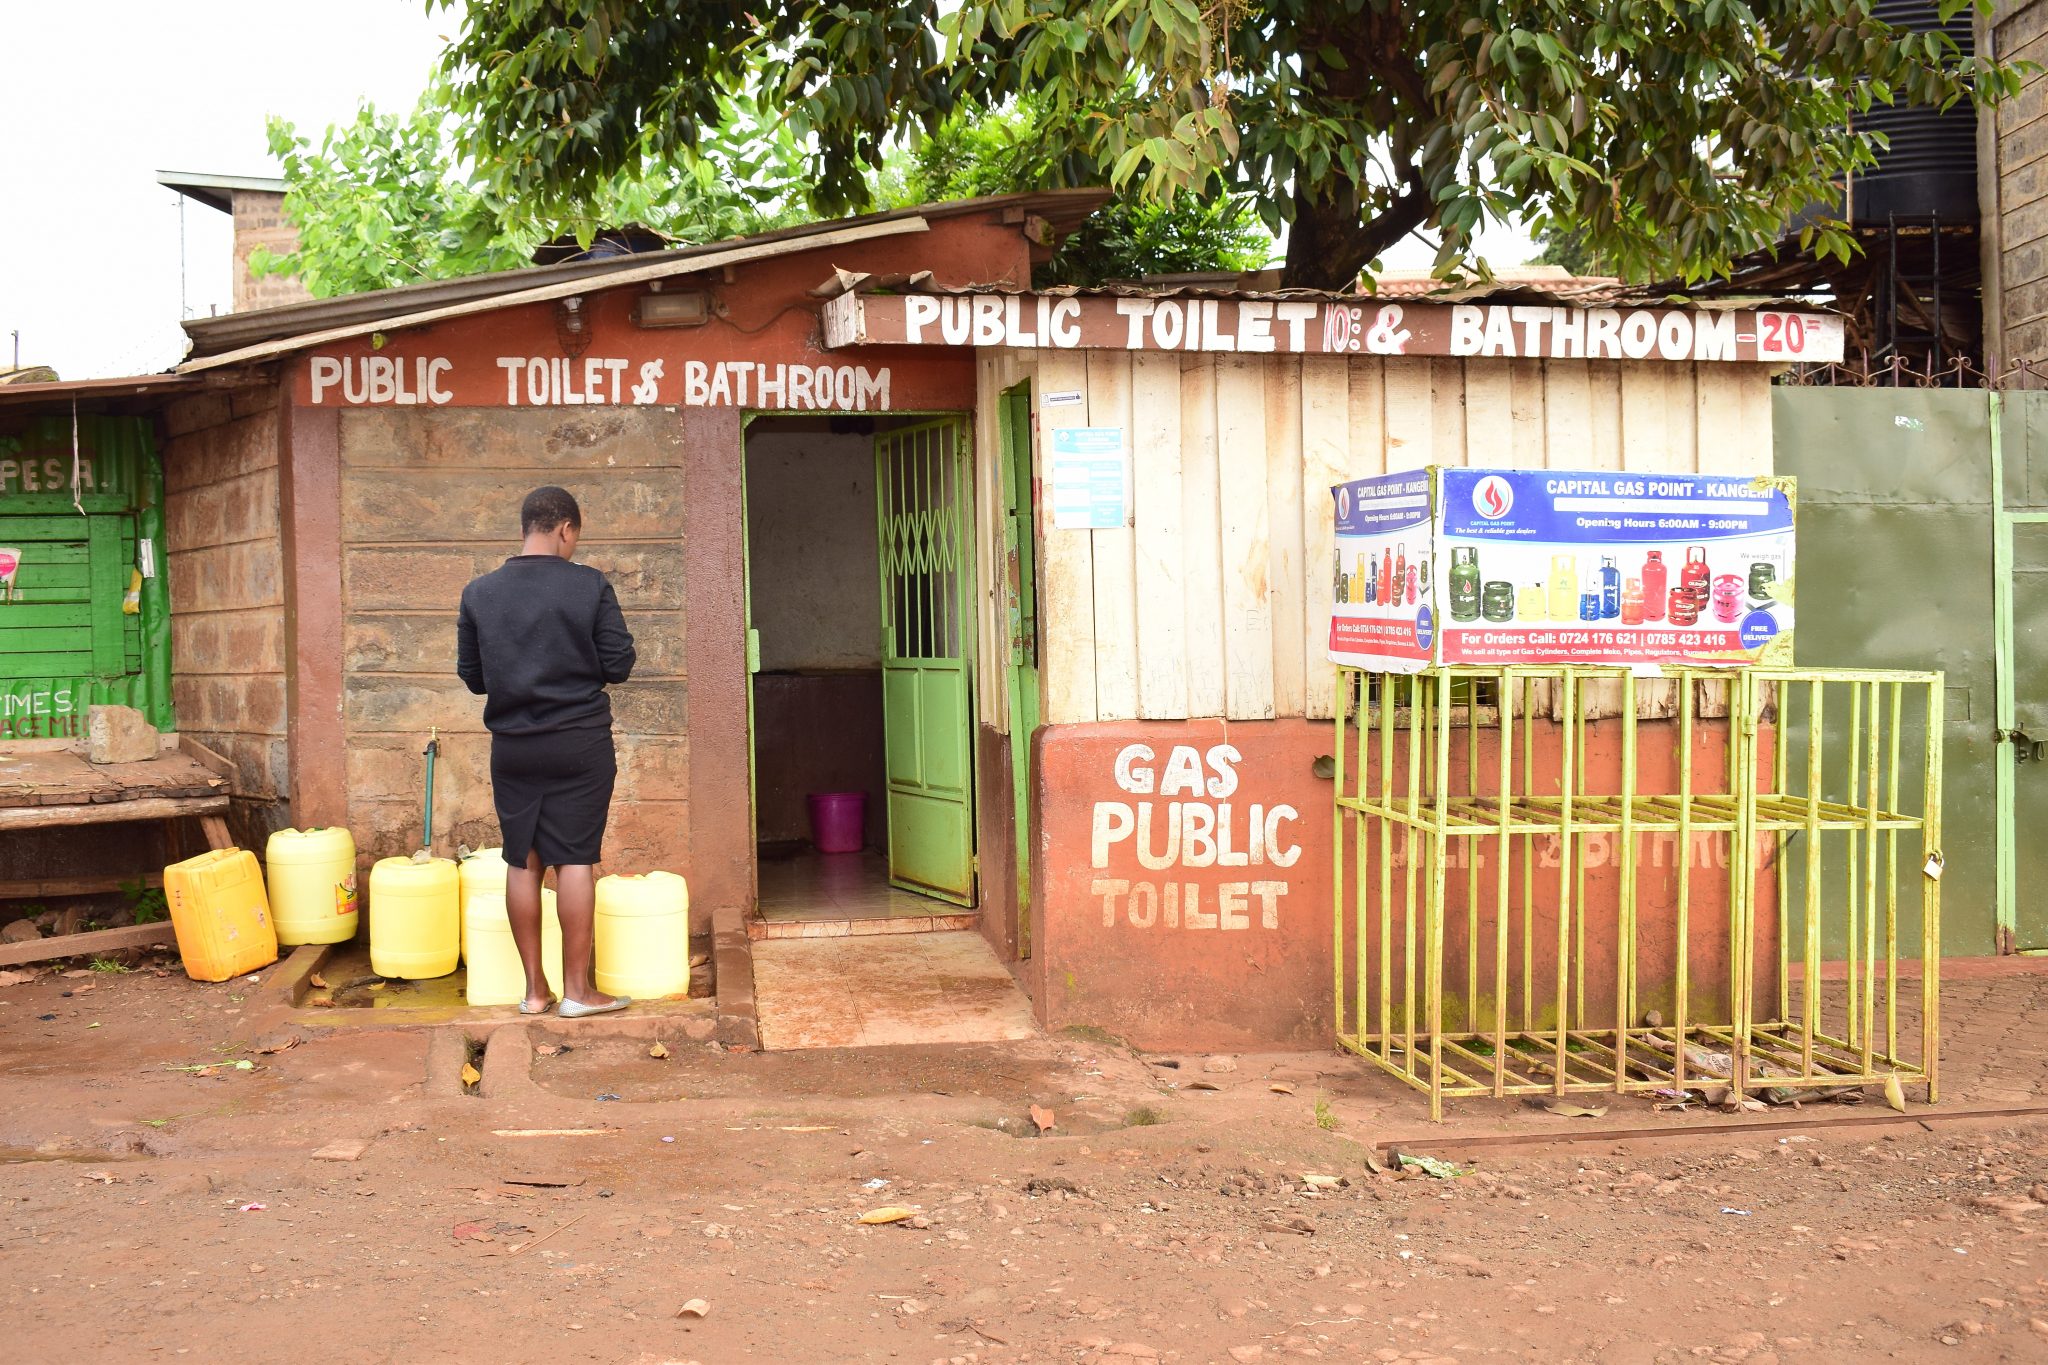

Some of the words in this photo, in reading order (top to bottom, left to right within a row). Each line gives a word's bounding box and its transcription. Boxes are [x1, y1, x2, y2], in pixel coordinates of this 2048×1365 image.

[905, 296, 1082, 348] PUBLIC
[1117, 297, 1317, 353] TOILET
[1365, 303, 1411, 355] &
[1450, 304, 1737, 361] BATHROOM
[310, 356, 454, 404] PUBLIC
[496, 356, 629, 406] TOILET
[684, 360, 892, 411] BATHROOM
[1546, 480, 1611, 495] CAPITAL
[1614, 481, 1645, 496] GAS
[1648, 482, 1695, 497] POINT
[1455, 527, 1466, 535] The
[1484, 527, 1505, 535] reliable
[1516, 528, 1536, 536] dealers
[1576, 517, 1621, 529] Opening
[1624, 517, 1656, 528] Hours
[1658, 518, 1699, 529] 6:00AM
[1708, 519, 1748, 530] 9:00PM
[1461, 632, 1481, 644] For
[1484, 632, 1526, 645] Orders
[1528, 632, 1557, 644] Call:
[1559, 632, 1589, 645] 0724
[1592, 632, 1613, 645] 176
[1616, 632, 1637, 645] 621
[1647, 633, 1676, 645] 0785
[1678, 633, 1701, 646] 423
[1703, 634, 1726, 646] 416
[1461, 648, 1472, 656] We
[1473, 648, 1486, 656] sell
[1496, 648, 1512, 657] type
[1521, 648, 1535, 656] Gas
[1571, 648, 1602, 657] Complete
[1114, 743, 1242, 799] GAS
[1091, 801, 1302, 871] PUBLIC
[1091, 879, 1289, 930] TOILET
